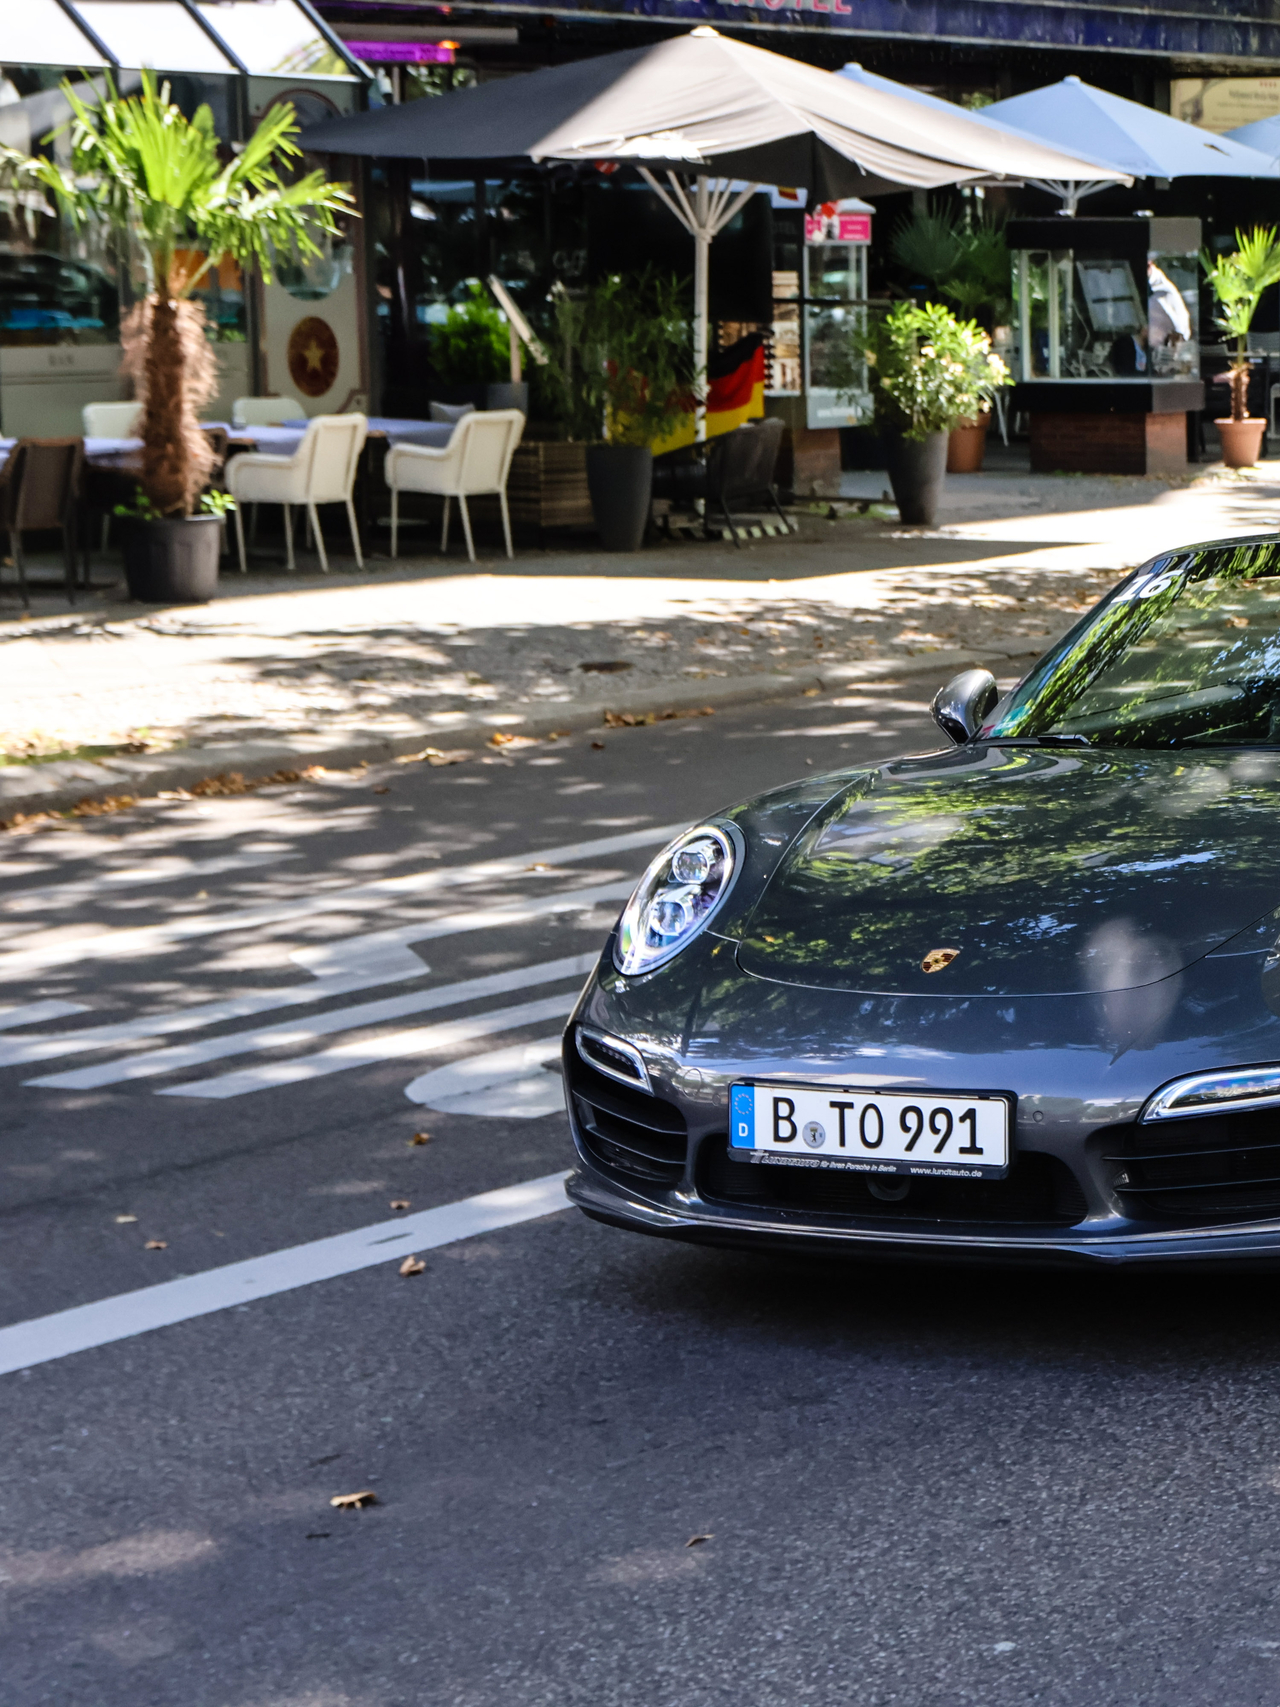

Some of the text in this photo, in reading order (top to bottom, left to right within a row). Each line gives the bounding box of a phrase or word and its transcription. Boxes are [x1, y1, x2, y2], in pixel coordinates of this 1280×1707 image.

[1112, 570, 1185, 603] 16
[738, 1122, 749, 1138] D
[772, 1097, 983, 1155] B TO 991
[845, 1162, 870, 1171] Porsche
[878, 1164, 897, 1173] Berlin
[910, 1167, 983, 1178] www.lundtauto.de
